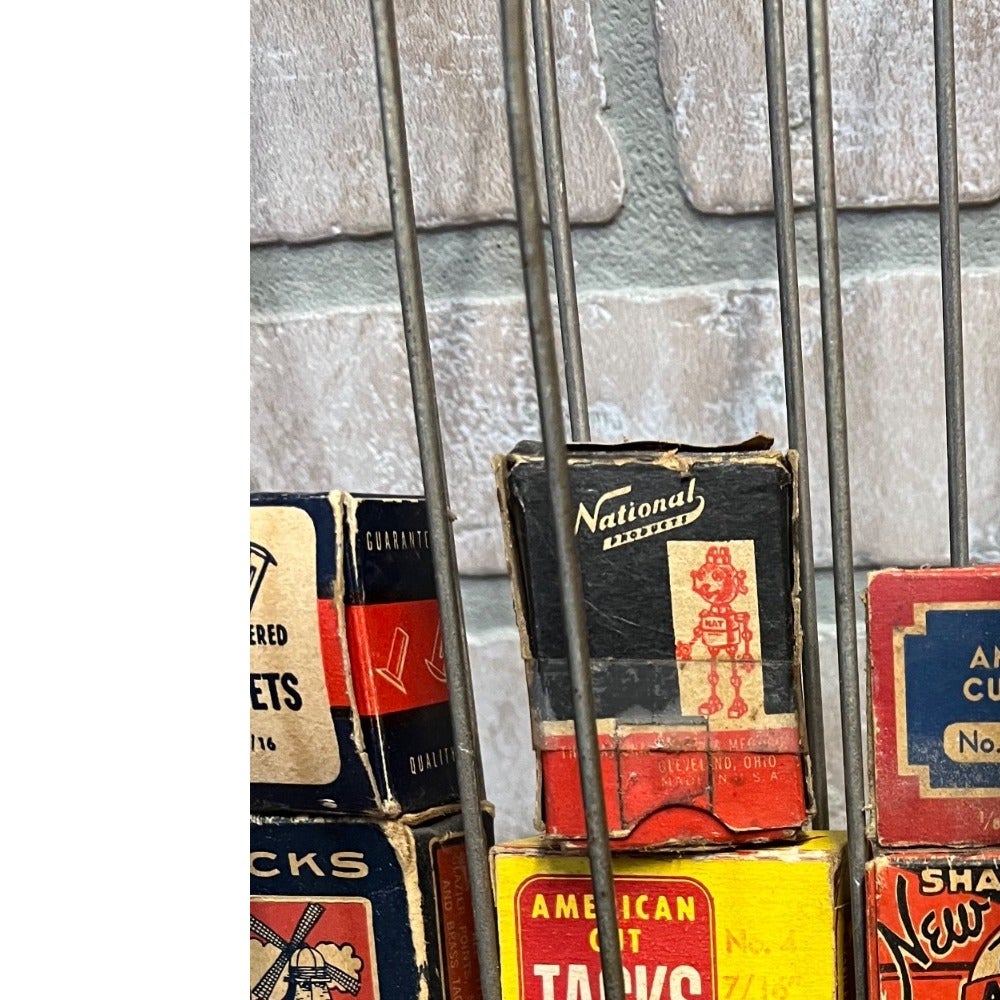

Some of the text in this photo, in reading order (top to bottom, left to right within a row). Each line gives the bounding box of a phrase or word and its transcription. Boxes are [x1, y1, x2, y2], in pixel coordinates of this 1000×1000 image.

[574, 477, 697, 536] National
[704, 619, 724, 628] NAT
[531, 893, 697, 922] AMEICAN
